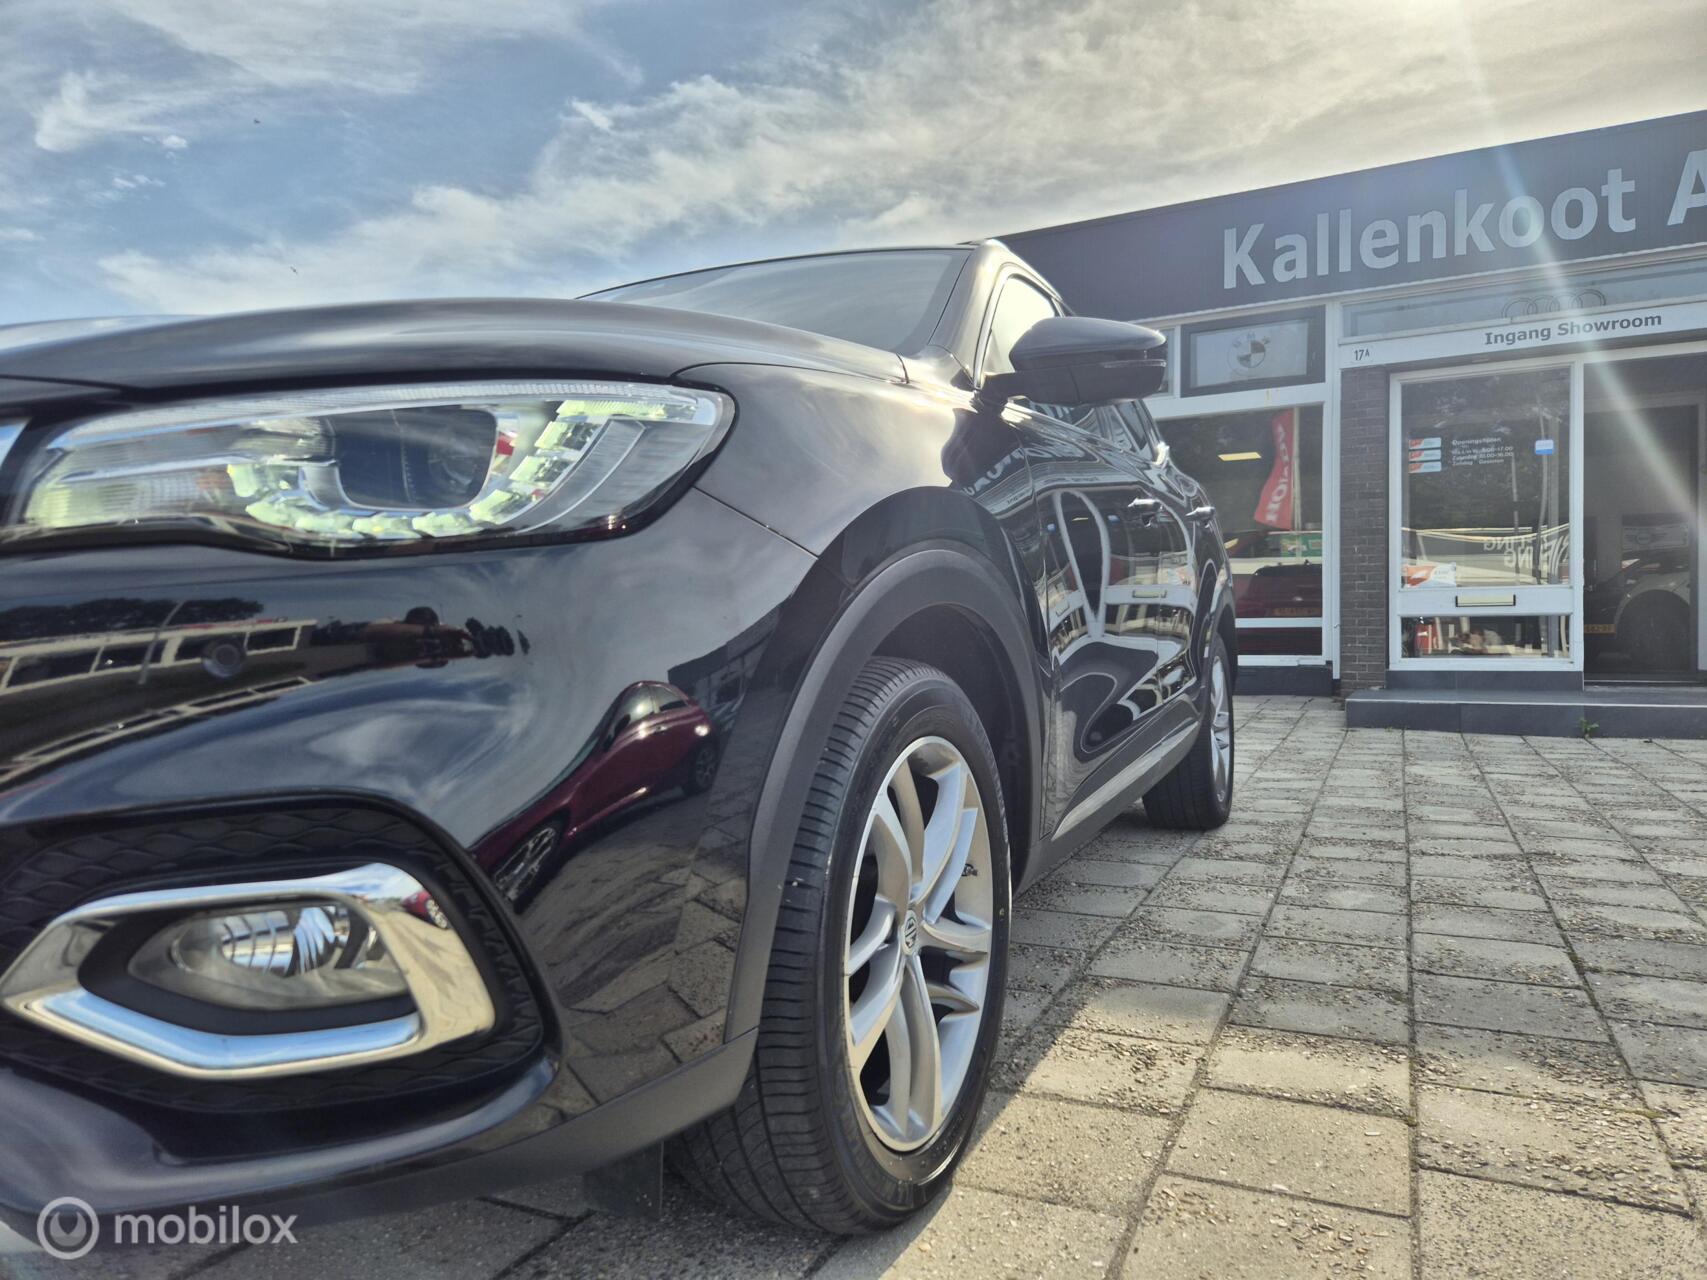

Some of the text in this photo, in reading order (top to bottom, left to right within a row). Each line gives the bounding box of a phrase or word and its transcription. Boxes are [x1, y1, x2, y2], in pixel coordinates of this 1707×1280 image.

[1222, 167, 1637, 290] Kallenkoot
[1484, 314, 1663, 346] Ingang Showroom
[1354, 348, 1370, 361] 17A
